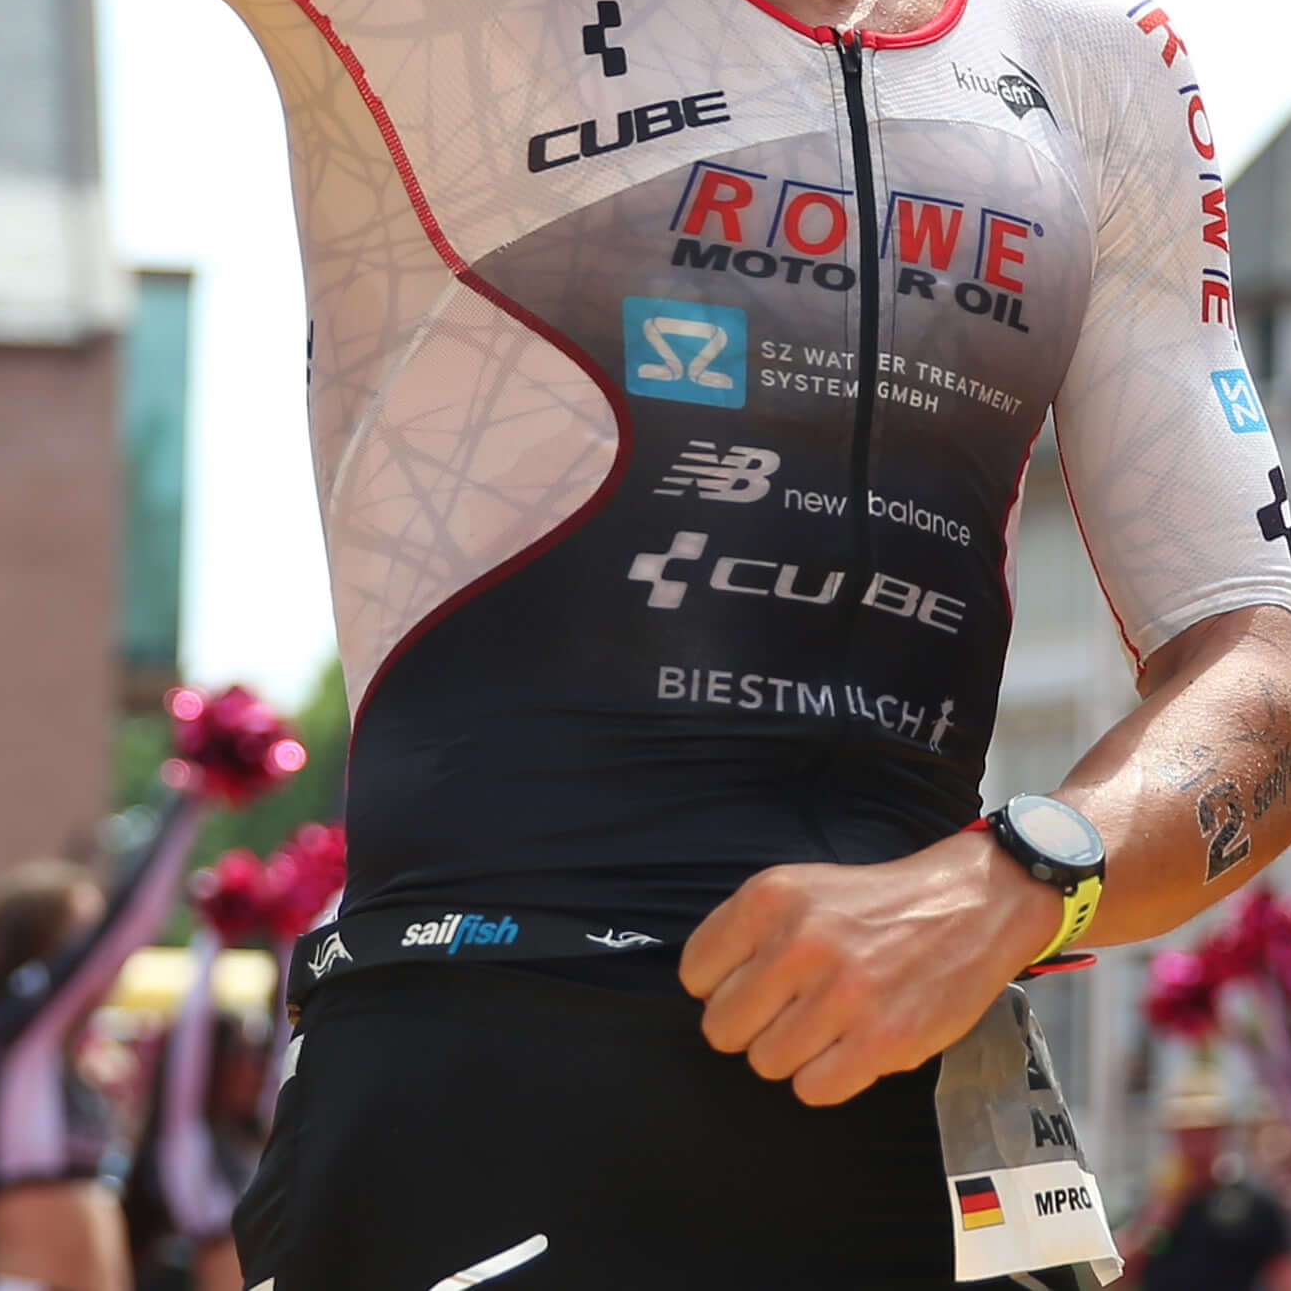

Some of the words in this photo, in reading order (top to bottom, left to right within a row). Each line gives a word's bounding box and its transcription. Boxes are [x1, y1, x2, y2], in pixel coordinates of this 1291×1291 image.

[527, 89, 731, 173] CUBE
[676, 165, 1031, 294] ROWE
[670, 237, 936, 301] MOTOR
[953, 281, 1030, 334] OIL
[760, 340, 793, 362] SZ
[915, 361, 1023, 415] TREATMENT
[760, 368, 859, 398] SYSTEM
[876, 381, 940, 413] GMBH
[783, 488, 848, 516] new
[867, 489, 972, 547] balance
[709, 556, 967, 634] CUBE
[1197, 777, 1252, 886] 2
[400, 913, 519, 955] sailfish
[1034, 1186, 1094, 1217] MPRO
